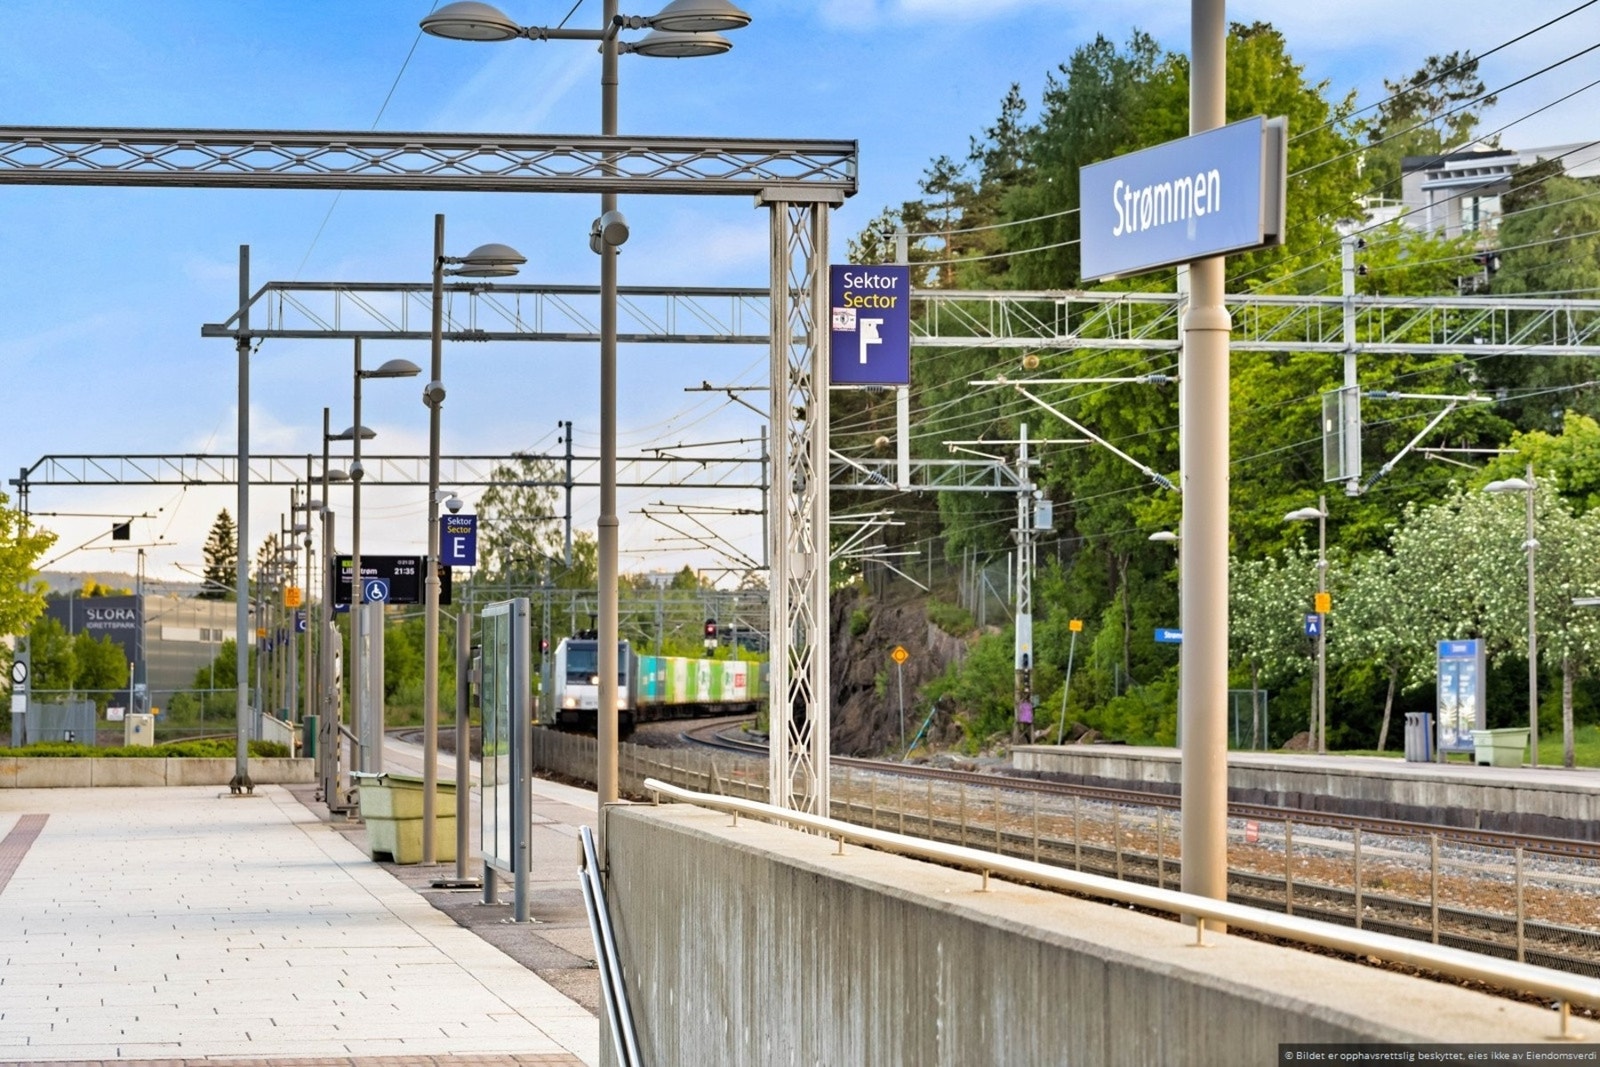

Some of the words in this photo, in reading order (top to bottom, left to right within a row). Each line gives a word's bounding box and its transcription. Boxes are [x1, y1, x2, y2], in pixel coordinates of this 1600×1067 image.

[1112, 168, 1221, 237] Strømmen
[843, 272, 898, 289] Sektor
[843, 291, 897, 308] Sector
[860, 318, 884, 364] F
[447, 517, 472, 525] Sektor
[447, 526, 472, 534] Sector
[453, 537, 466, 558] E
[394, 567, 415, 575] 21:35
[86, 609, 136, 620] SLORA
[1309, 622, 1317, 632] A
